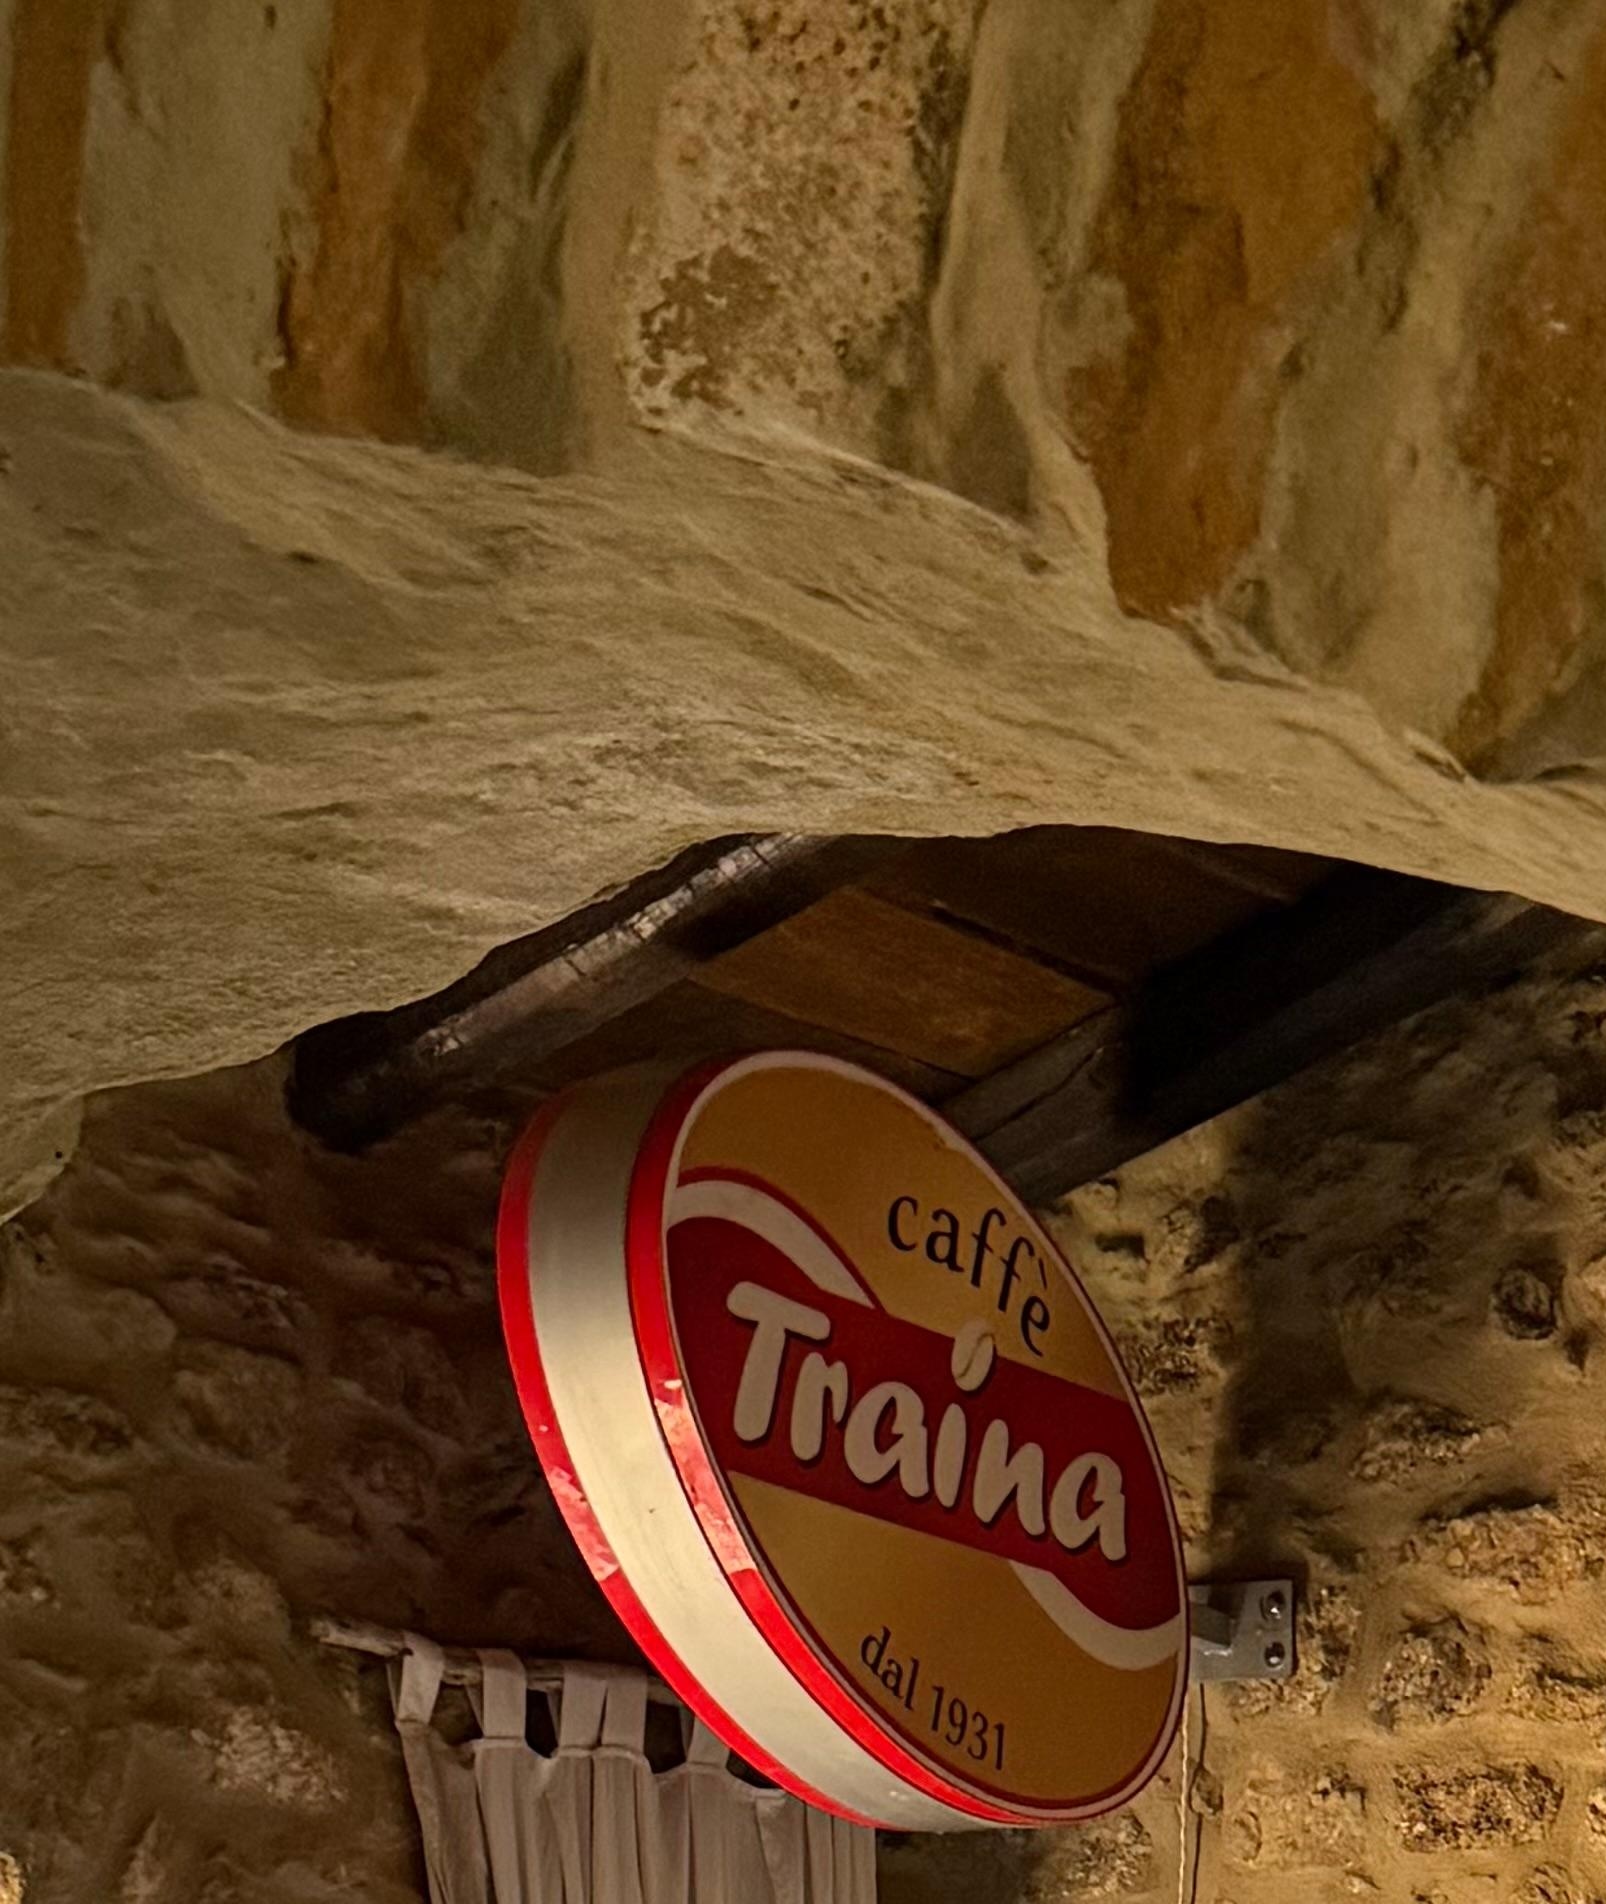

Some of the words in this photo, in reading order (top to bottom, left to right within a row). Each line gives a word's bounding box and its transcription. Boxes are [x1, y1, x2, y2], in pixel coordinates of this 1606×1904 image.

[887, 1194, 1051, 1357] caffè
[727, 1282, 1128, 1561] Traina
[860, 1627, 916, 1711] dal
[930, 1684, 1006, 1771] 1931
